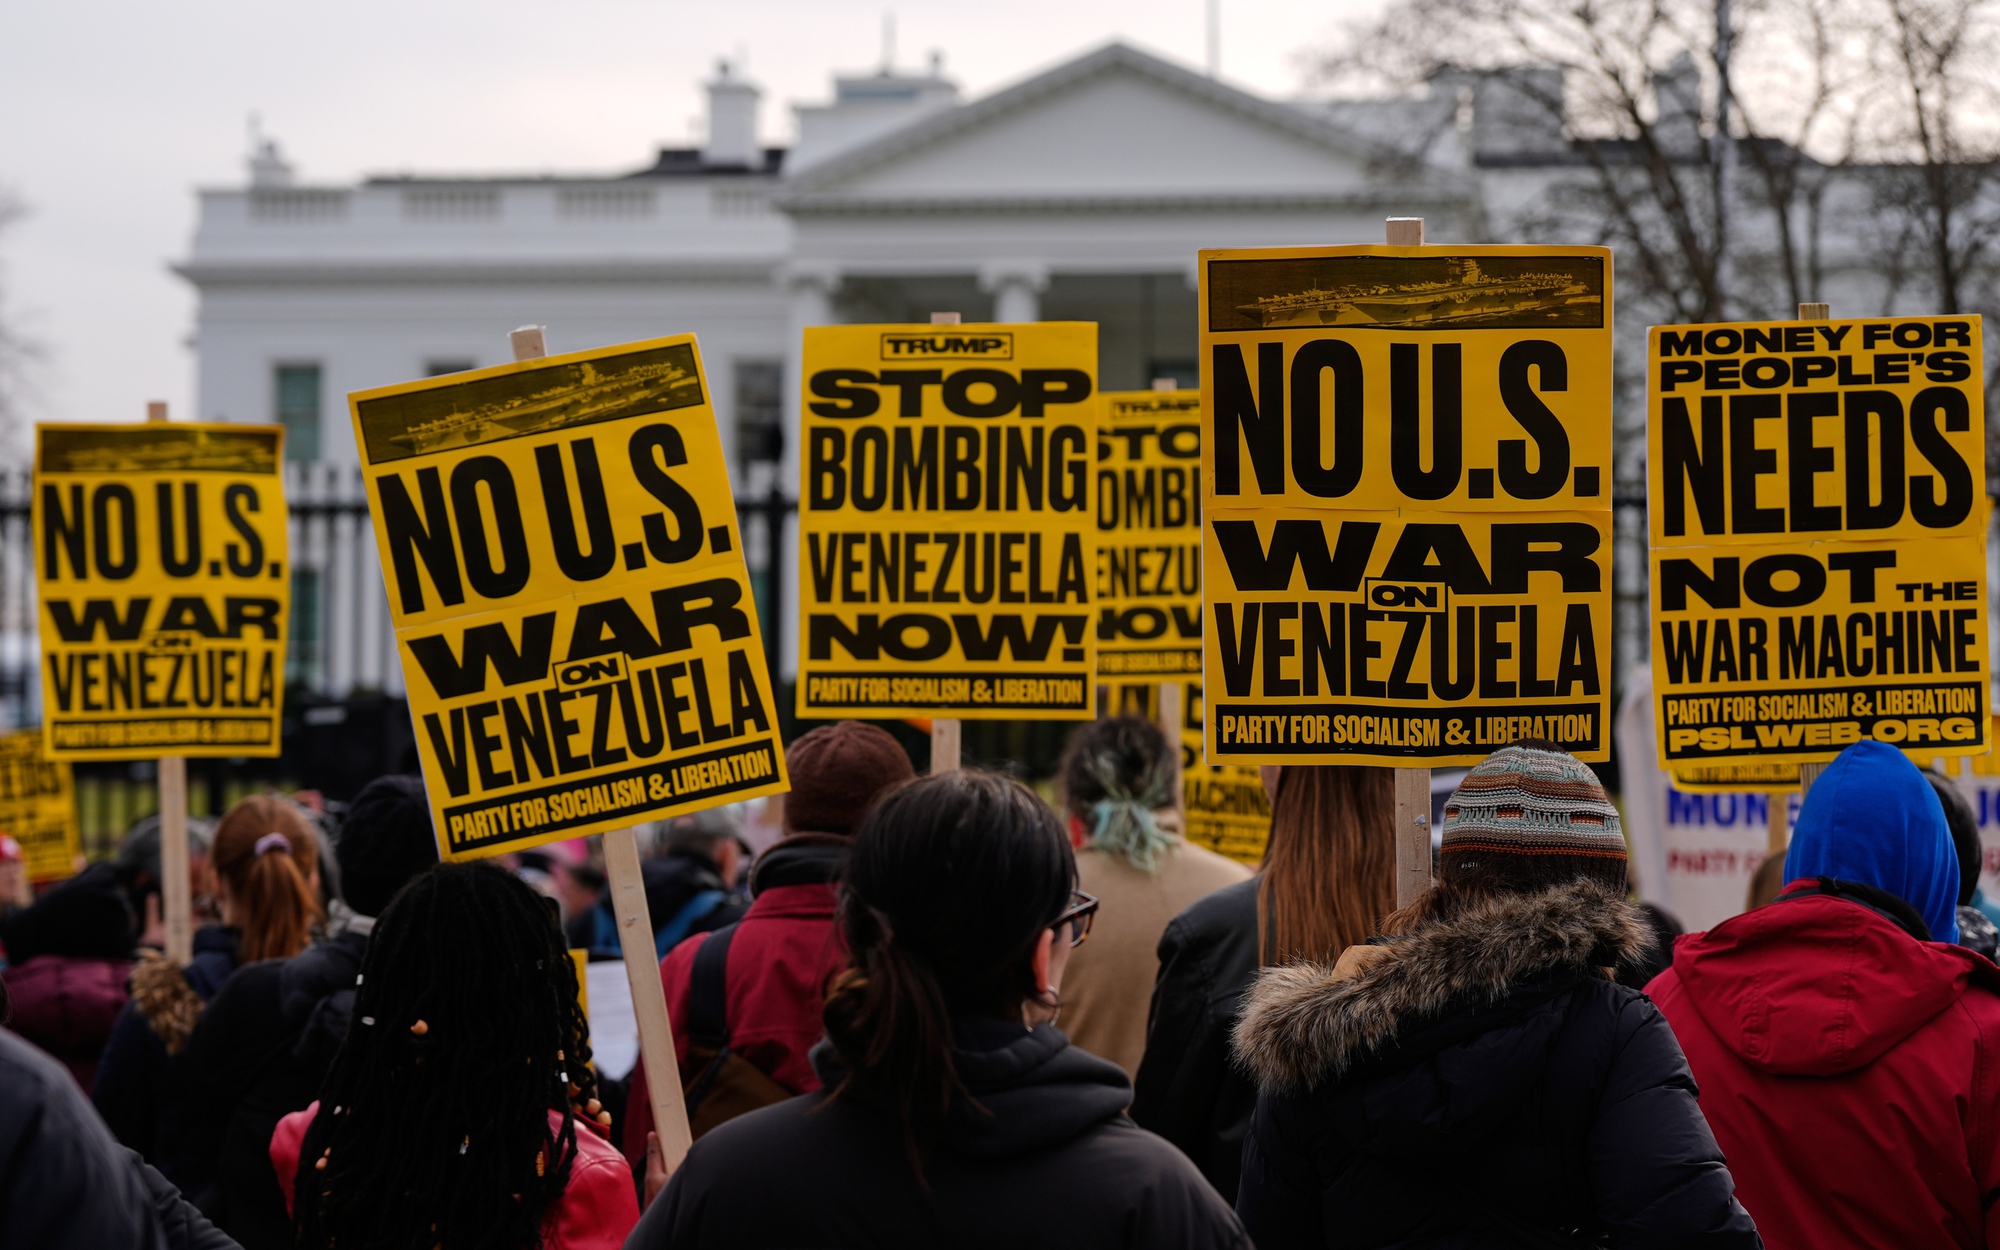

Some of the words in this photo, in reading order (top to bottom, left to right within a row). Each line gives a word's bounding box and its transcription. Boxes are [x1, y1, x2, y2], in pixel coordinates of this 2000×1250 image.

[886, 337, 1008, 354] TRUMP:
[1660, 325, 1853, 357] MONEY
[1863, 321, 1971, 350] FOR
[808, 368, 1092, 419] STOP
[1660, 351, 1971, 392] PEOPLE'S
[1212, 339, 1364, 498] NO
[1390, 339, 1600, 500] U.S.
[809, 425, 1087, 512] BOMBING
[1662, 386, 1973, 537] NEEDS
[376, 455, 531, 615] NO
[534, 423, 732, 582] U.S.
[1098, 467, 1201, 530] OMBI
[42, 483, 139, 580] NO
[156, 482, 281, 578] U.S.
[1213, 520, 1602, 595] WAR
[808, 532, 1089, 604] VENEZUELA
[1371, 585, 1438, 607] ON
[1660, 550, 1896, 611] NOT
[1896, 581, 1977, 602] THE
[46, 597, 280, 642] WAR
[152, 637, 193, 648] ON
[405, 577, 753, 700] WAR
[808, 612, 1089, 662] NOW!
[1660, 617, 1769, 685] WAR
[1778, 608, 1980, 680] MACHINE
[50, 650, 274, 711] VENEZUELA
[560, 658, 620, 686] ON
[1214, 602, 1601, 701] VENEZUELA
[809, 677, 859, 702] PARTY
[860, 678, 890, 702] FOR
[891, 678, 970, 703] SOCIALISM
[972, 678, 994, 703] &
[994, 679, 1083, 704] LIBERATION
[1667, 697, 1721, 725] PARTY
[1722, 695, 1757, 723] FOR
[1758, 692, 1848, 722] SOCIALISM
[1851, 692, 1874, 716] &
[1875, 687, 1976, 716] LIBERATION
[422, 649, 771, 798] VENEZUELA
[1222, 715, 1287, 744] PARTY
[1290, 715, 1330, 744] FOR
[1333, 716, 1440, 747] SOCIALISM
[1445, 718, 1471, 746] &
[1475, 714, 1592, 745] LIBERATION
[1669, 717, 1976, 752] PSLWEB.ORG
[450, 804, 511, 844] PARTY
[512, 797, 550, 829] FOR
[551, 775, 645, 819] SOCIALISM
[648, 772, 674, 800] &
[671, 748, 773, 793] LIBERATION
